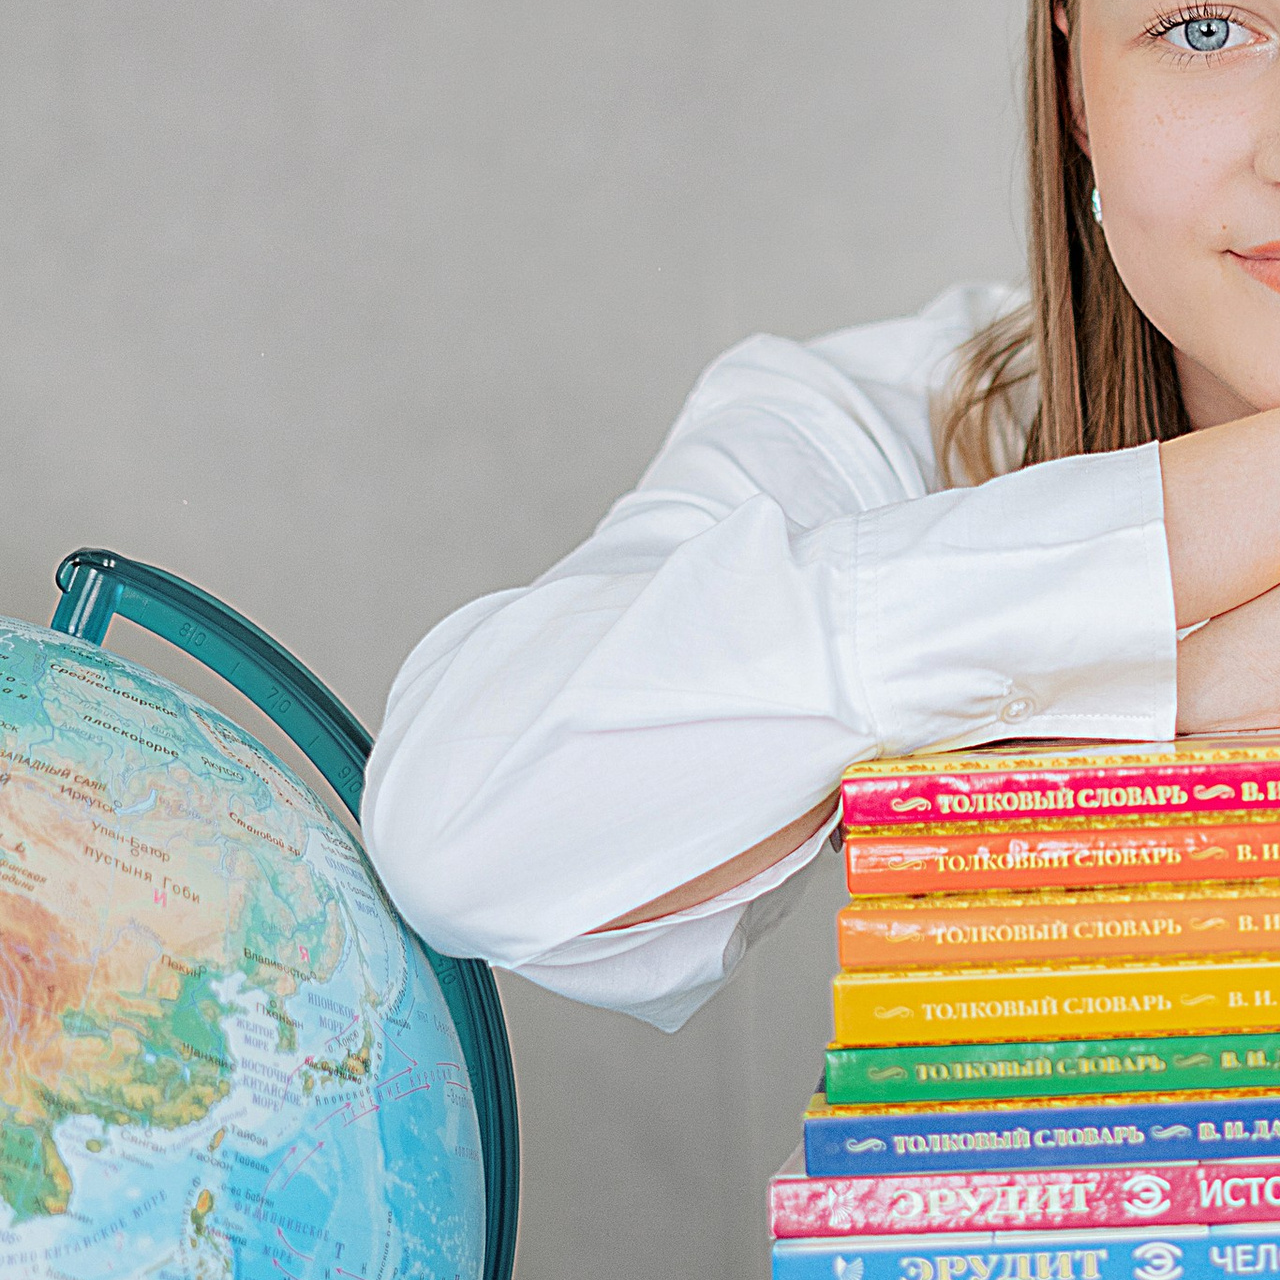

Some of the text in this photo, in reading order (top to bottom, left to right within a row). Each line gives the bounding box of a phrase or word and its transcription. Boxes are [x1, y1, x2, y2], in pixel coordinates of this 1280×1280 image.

[50, 663, 179, 719] Среднесибирское
[83, 713, 180, 758] плоскогорье
[60, 784, 118, 815] Иркутск
[74, 774, 108, 792] САЯН
[937, 788, 1073, 814] ТОЛКОВЫЙ
[1077, 784, 1188, 809] СЛОВАРЬ
[1241, 784, 1263, 802] В.
[91, 820, 171, 862] Улан-Батор
[229, 811, 285, 849] Становой
[84, 844, 200, 904] пустыня Гоби
[936, 849, 1069, 873] ТОЛКОВЫЙ
[1072, 845, 1182, 867] СЛОВАРЬ
[1237, 843, 1258, 862] В.
[934, 921, 1068, 945] ТОЛКОВЫЙ
[1072, 918, 1182, 940] СЛОВАРЬ
[1238, 914, 1259, 932] В.
[161, 953, 202, 979] Пекин
[243, 947, 315, 984] Владивосток
[922, 997, 1058, 1020] ТОЛКОВЫЙ
[1063, 995, 1172, 1014] СЛОВАРЬ
[1228, 990, 1248, 1008] В.
[1252, 988, 1278, 1006] И.
[915, 1057, 1052, 1081] ТОЛКОВЫЙ
[1056, 1054, 1167, 1076] СЛОВАРЬ
[1220, 1050, 1241, 1069] В.
[1246, 1048, 1270, 1068] И.
[893, 1128, 1030, 1154] ТОЛКОВЫЙ
[1034, 1125, 1145, 1148] СЛОВАРЬ
[1199, 1122, 1221, 1140] В.
[1224, 1120, 1250, 1139] И.
[891, 1182, 1096, 1220] ЭРУДИТ
